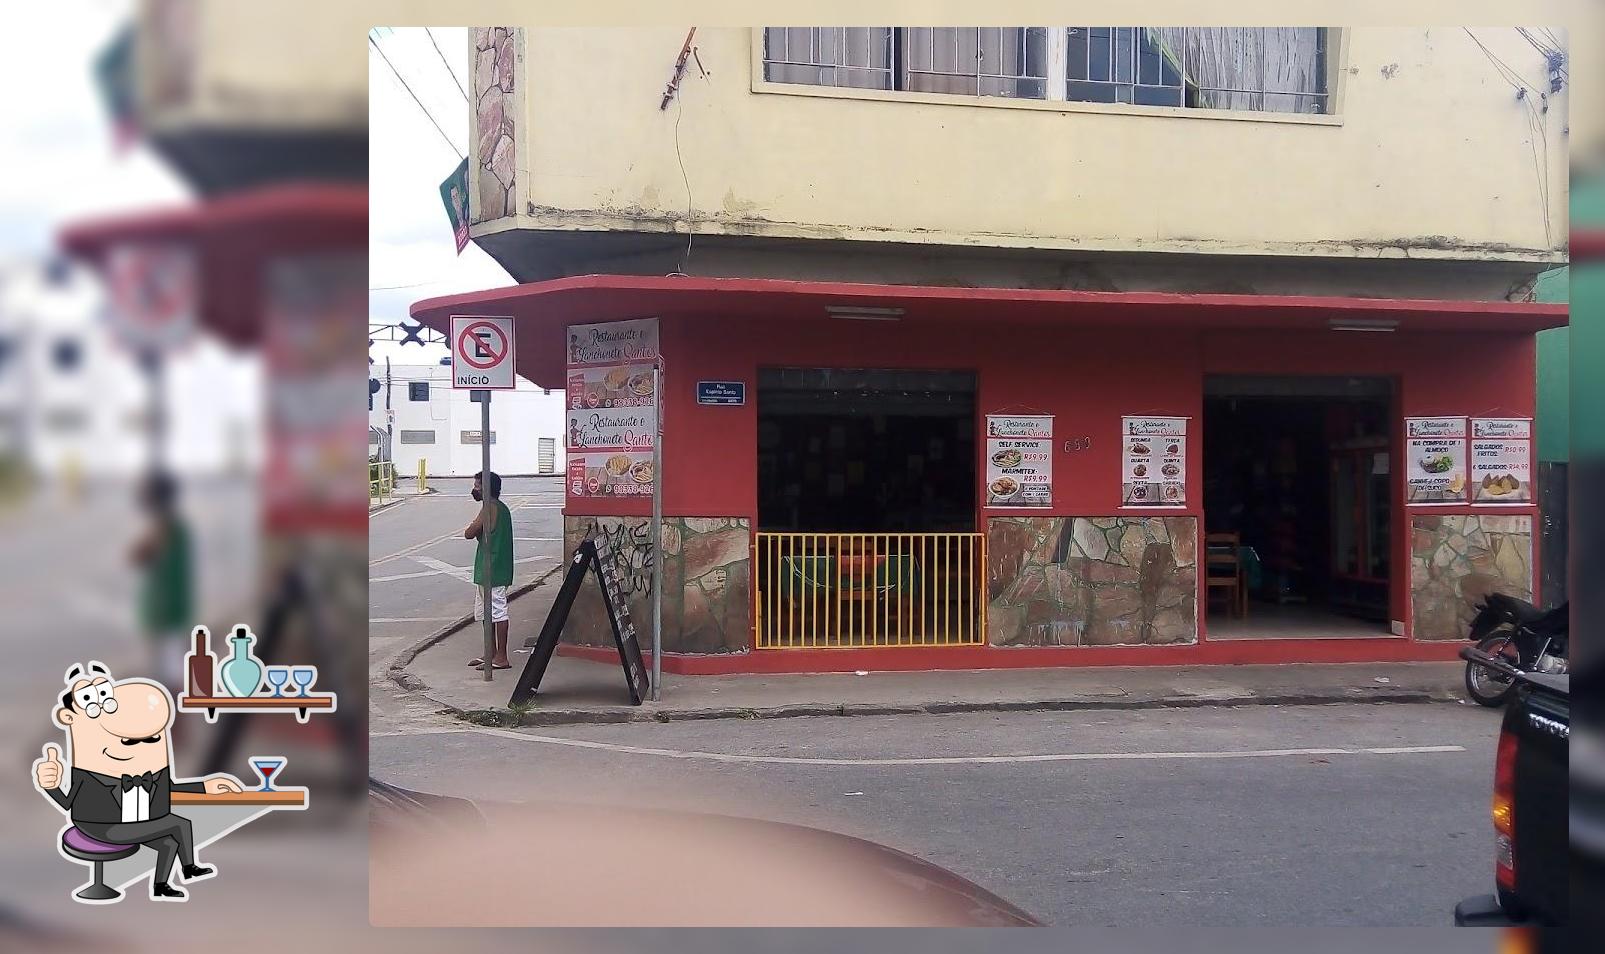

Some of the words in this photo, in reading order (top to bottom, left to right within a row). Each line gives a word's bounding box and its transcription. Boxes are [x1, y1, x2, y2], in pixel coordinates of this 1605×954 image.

[589, 328, 635, 346] Restaurante
[457, 375, 489, 385] INÍCIO
[589, 413, 637, 432] Restaurante
[580, 425, 622, 448] Lanchonete
[624, 430, 653, 451] Santo
